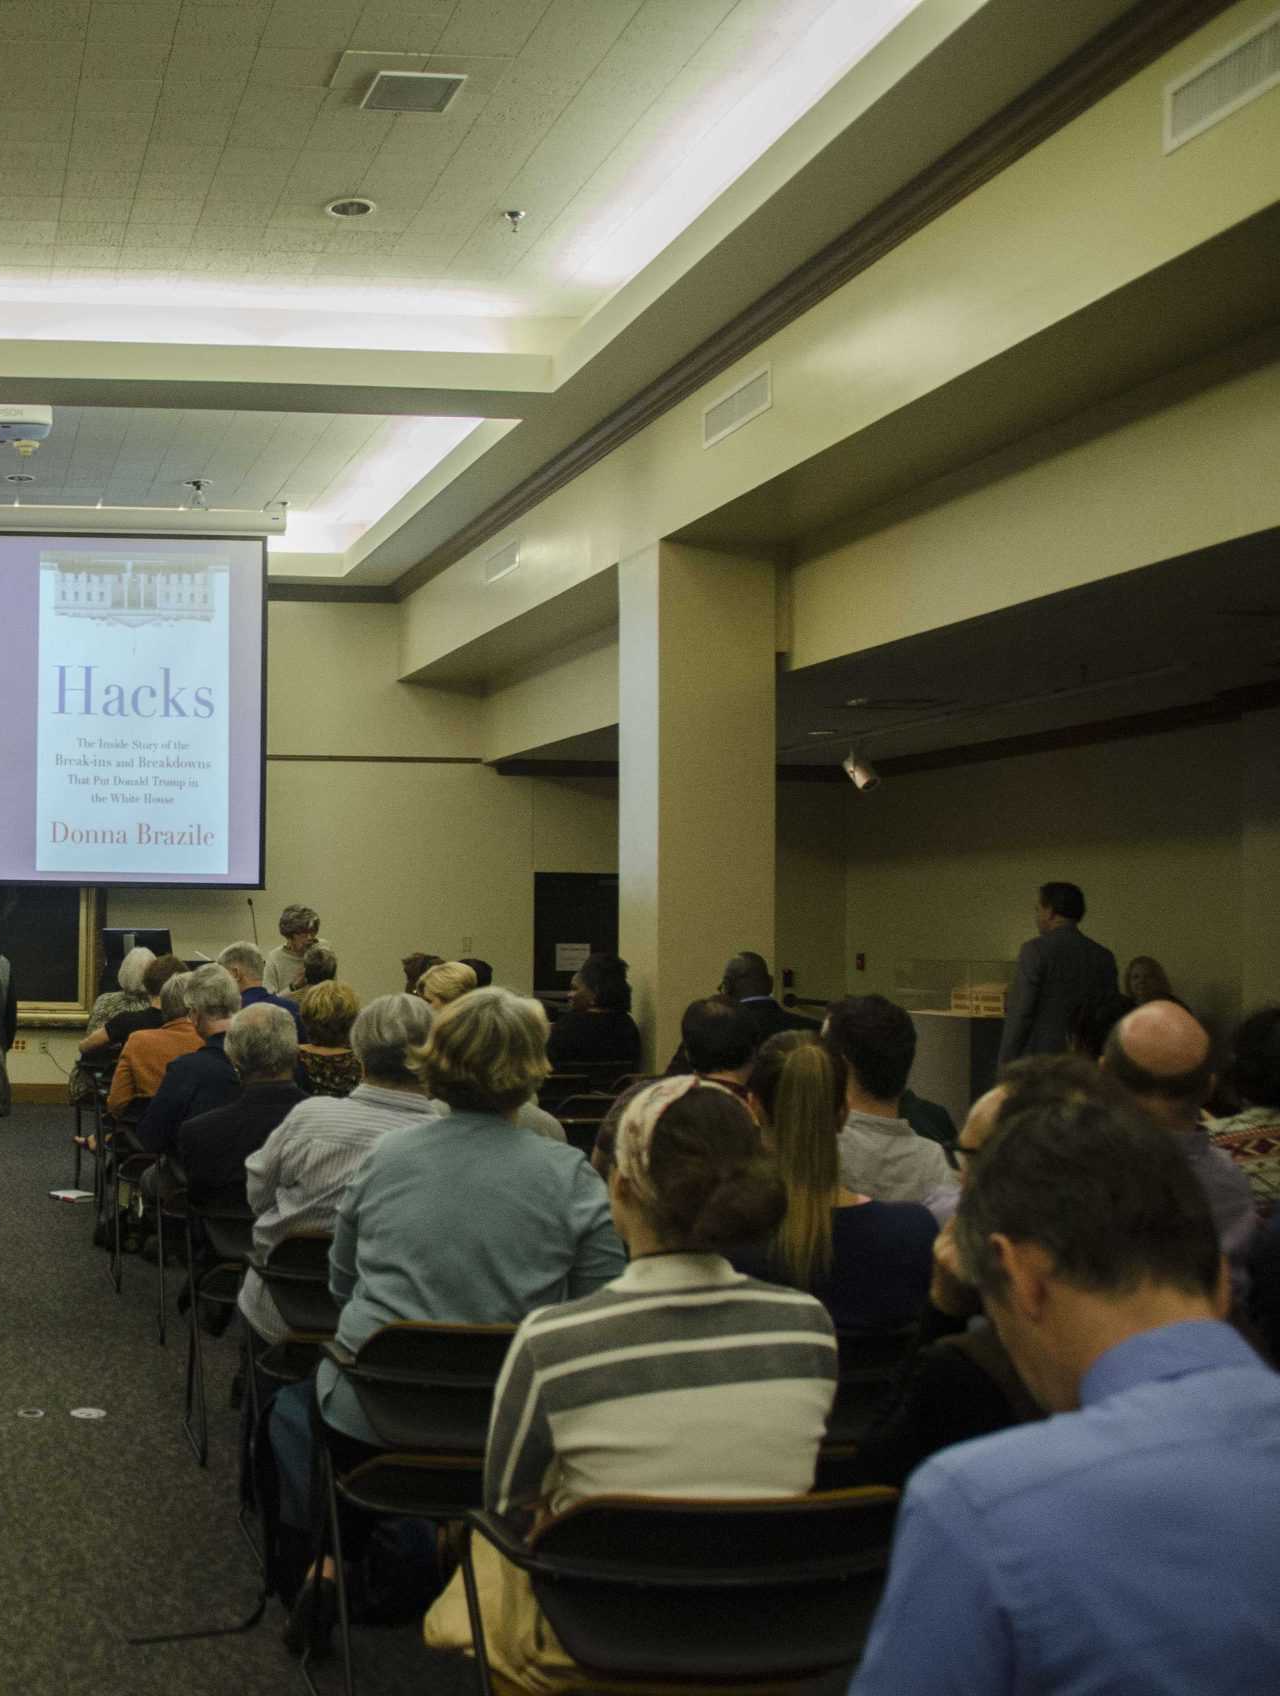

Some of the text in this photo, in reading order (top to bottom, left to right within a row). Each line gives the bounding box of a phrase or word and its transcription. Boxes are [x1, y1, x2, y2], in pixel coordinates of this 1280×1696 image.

[52, 665, 215, 719] Hacks
[76, 738, 190, 752] The Inside Story of the
[55, 754, 212, 769] Break-ins and Breakdowns
[68, 774, 199, 790] That Put Donald Trump in
[91, 794, 174, 804] the White House
[50, 821, 215, 847] Donna Brazile
